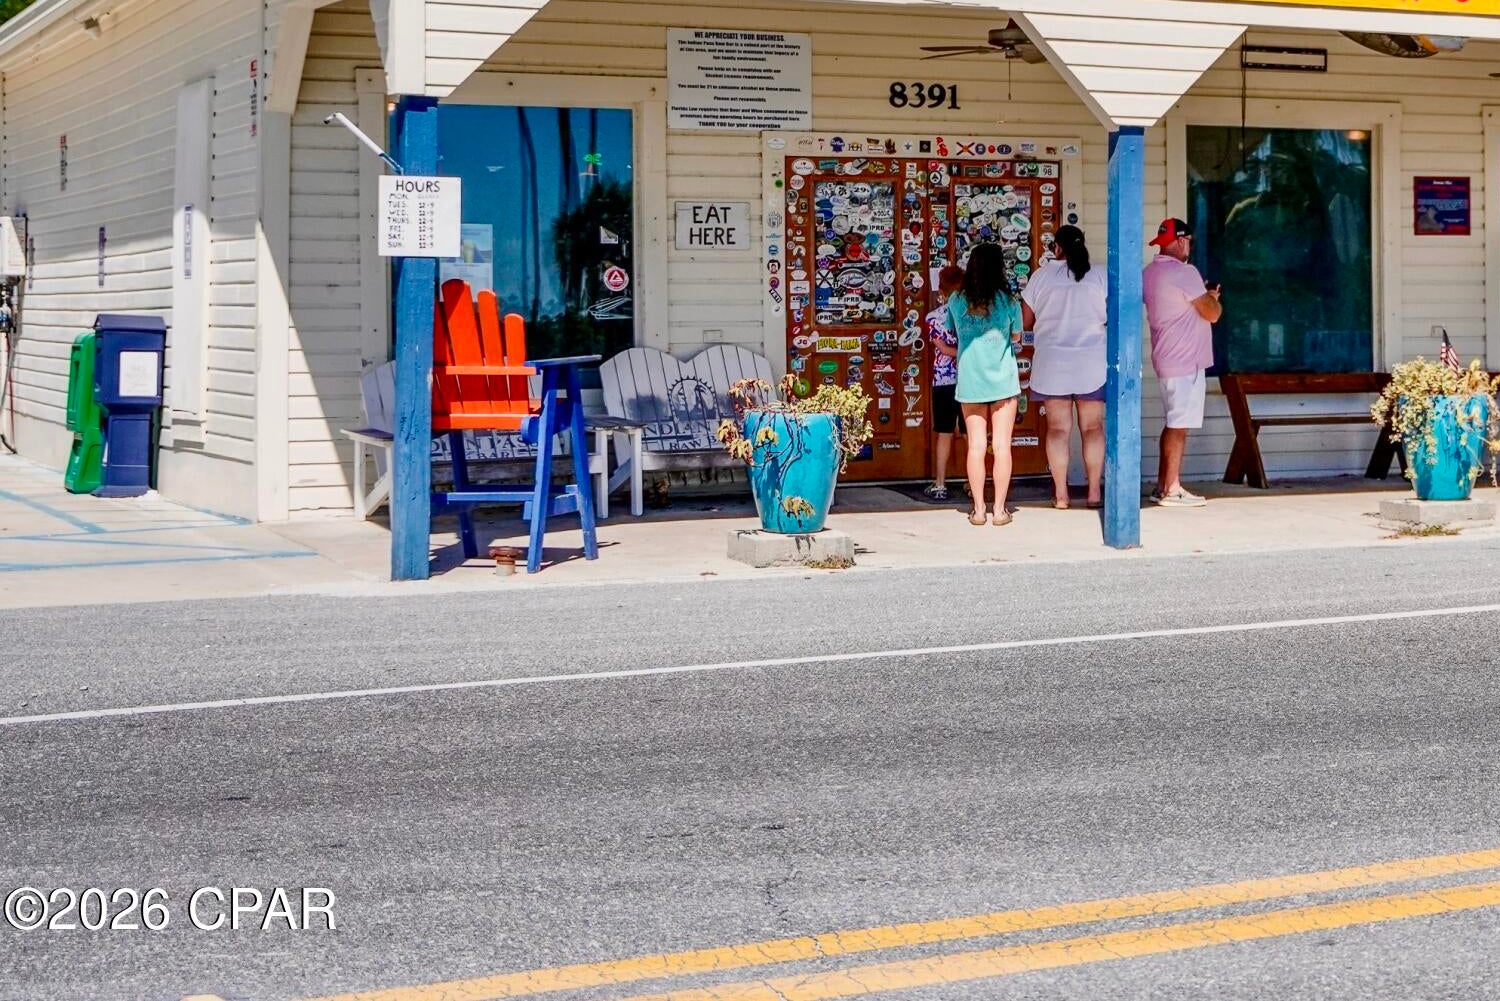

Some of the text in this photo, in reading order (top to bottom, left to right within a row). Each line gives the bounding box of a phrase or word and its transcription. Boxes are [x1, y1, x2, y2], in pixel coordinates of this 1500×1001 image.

[694, 31, 703, 39] WE
[704, 32, 738, 40] APPRECIATE
[740, 33, 755, 41] YOUR
[888, 81, 961, 110] 8391
[395, 179, 440, 193] HOURS
[692, 206, 732, 225] EAT
[689, 227, 737, 247] HERE
[643, 421, 712, 437] NDIAN
